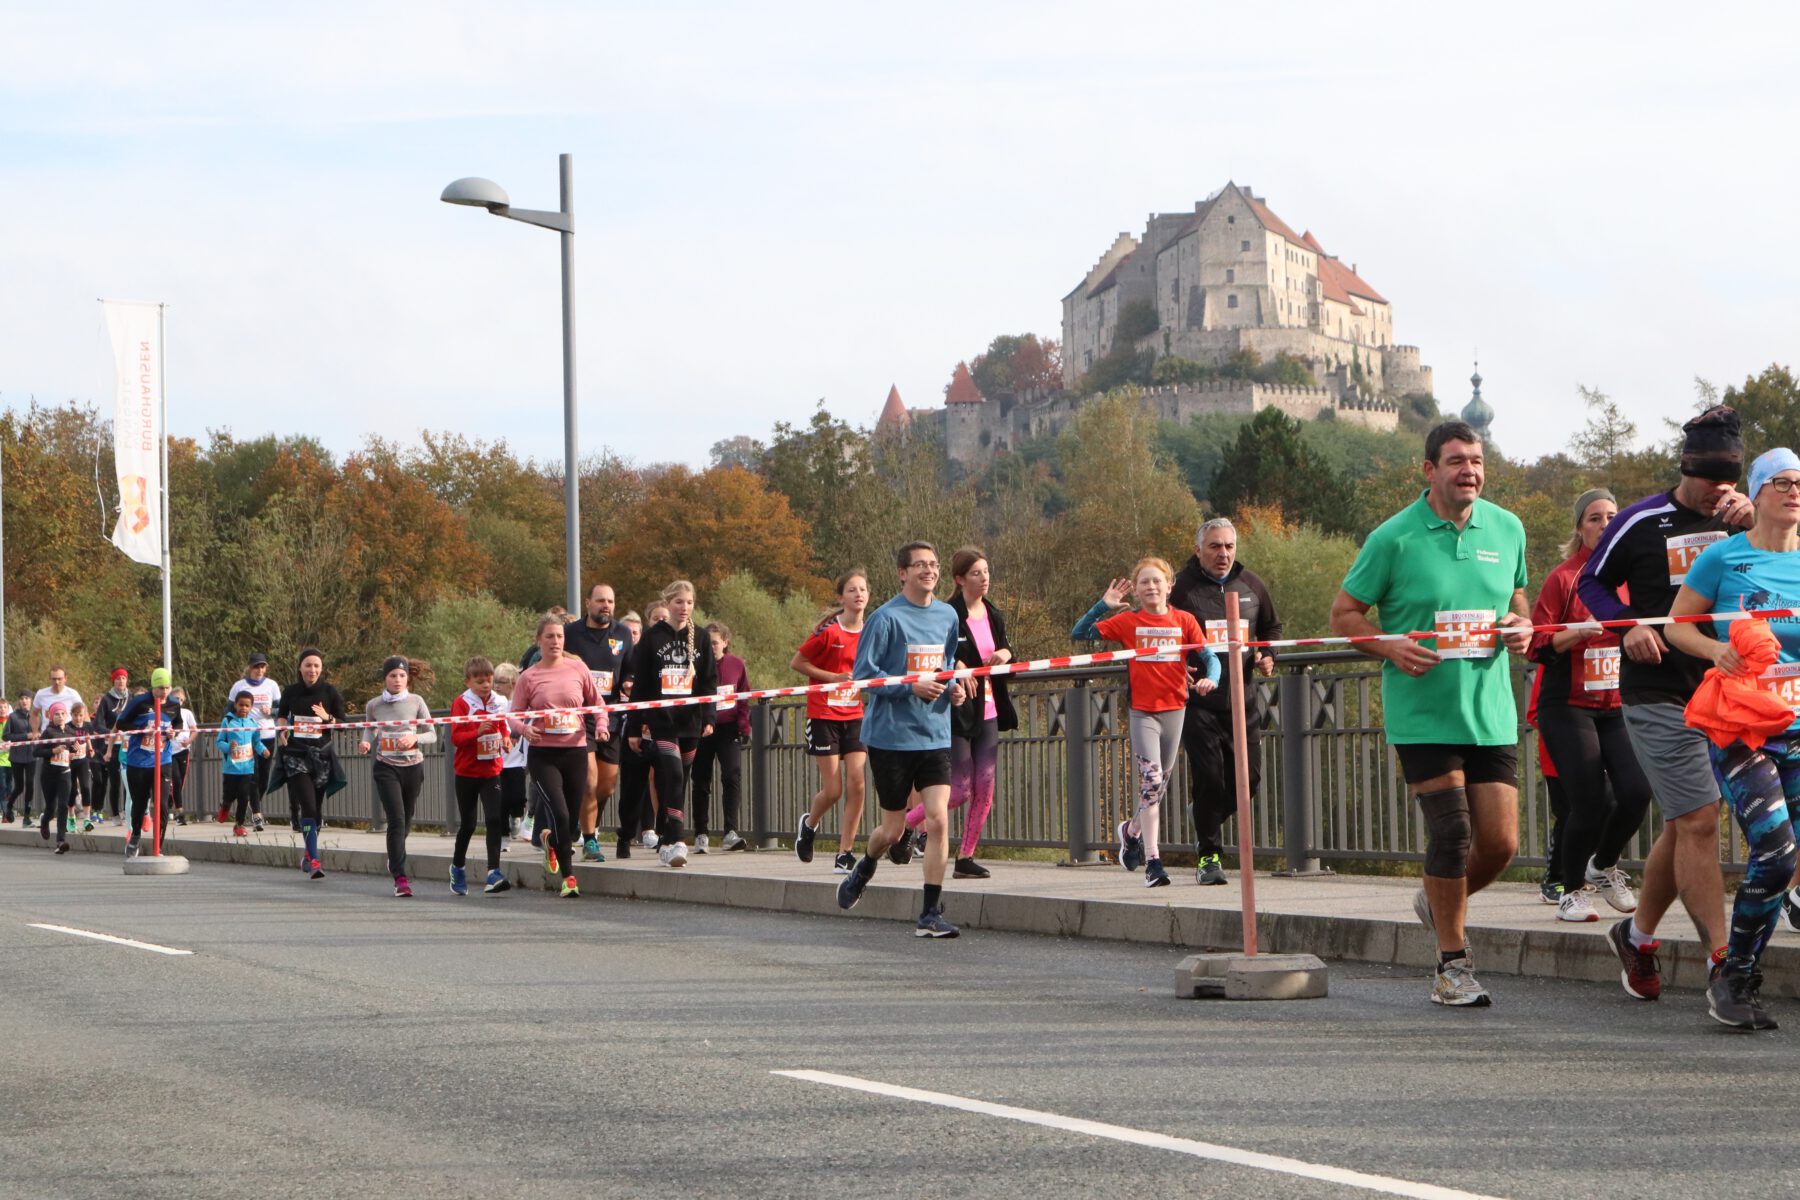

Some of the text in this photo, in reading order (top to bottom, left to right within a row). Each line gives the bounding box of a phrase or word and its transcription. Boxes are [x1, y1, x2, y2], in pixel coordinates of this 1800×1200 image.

[1732, 562, 1754, 574] 4F
[657, 642, 671, 657] JEAN
[1592, 657, 1621, 676] 106
[594, 678, 609, 688] 280
[1767, 678, 1800, 702] 145
